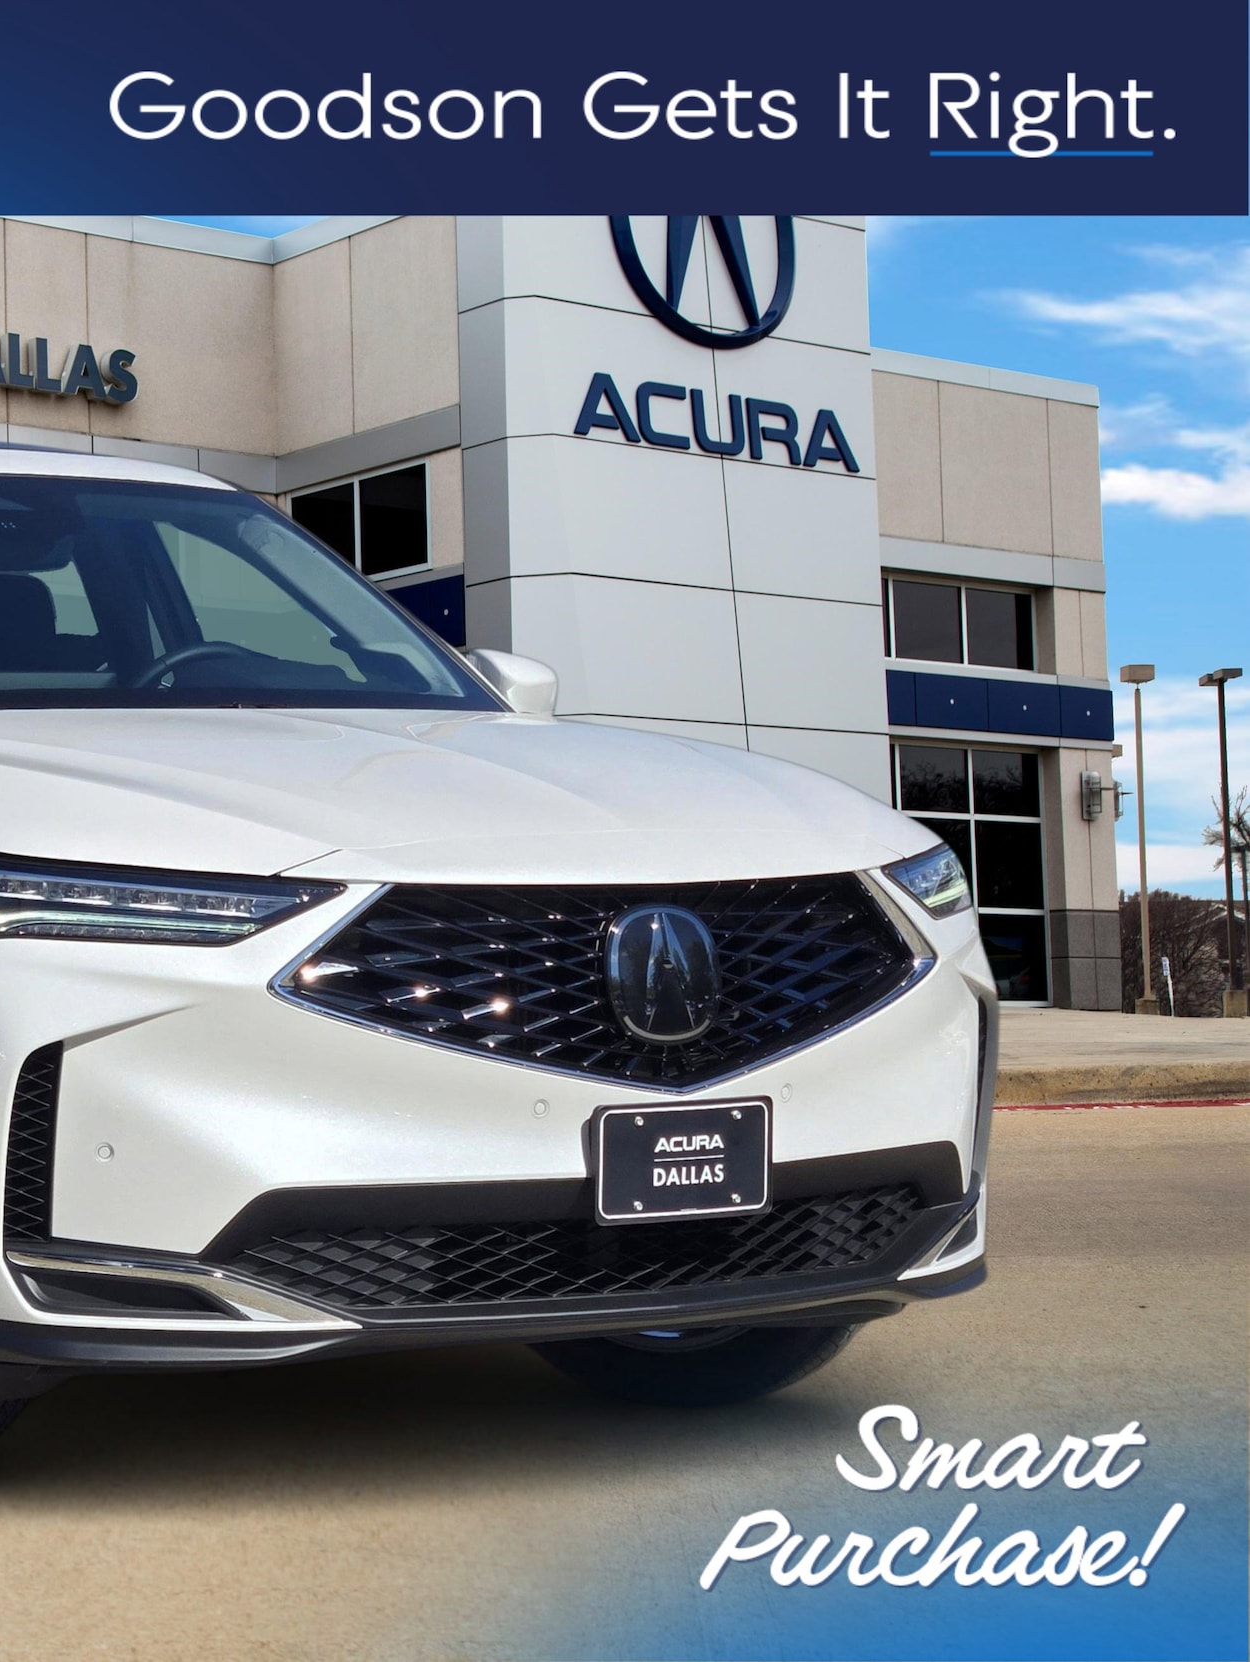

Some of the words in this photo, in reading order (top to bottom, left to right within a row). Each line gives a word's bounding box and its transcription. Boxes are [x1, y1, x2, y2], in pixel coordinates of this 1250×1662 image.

[573, 371, 861, 474] ACURA
[653, 1133, 725, 1154] ACURA
[652, 1163, 725, 1187] DALLAS
